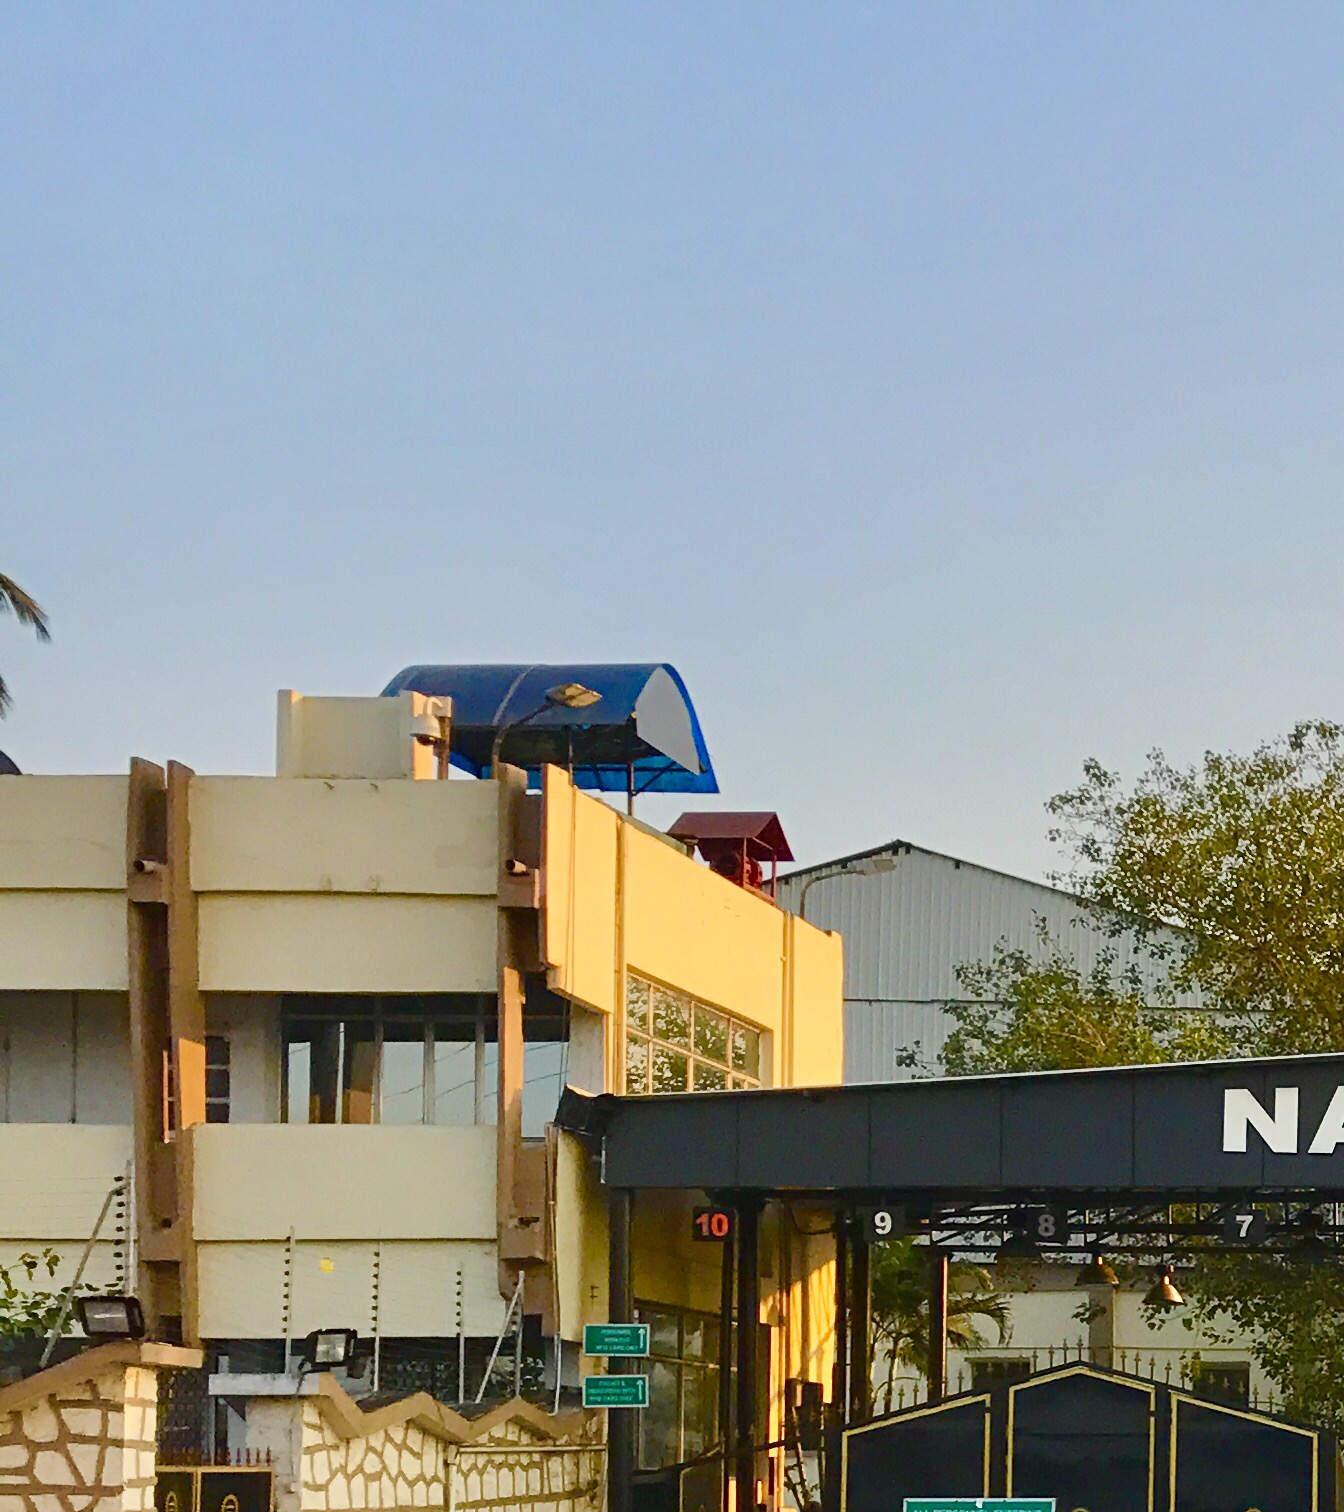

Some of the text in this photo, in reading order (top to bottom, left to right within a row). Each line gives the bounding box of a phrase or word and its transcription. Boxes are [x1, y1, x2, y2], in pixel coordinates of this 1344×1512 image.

[695, 1212, 729, 1236] 10
[874, 1211, 892, 1235] 9
[1037, 1214, 1056, 1237] 8
[1235, 1215, 1254, 1238] 7
